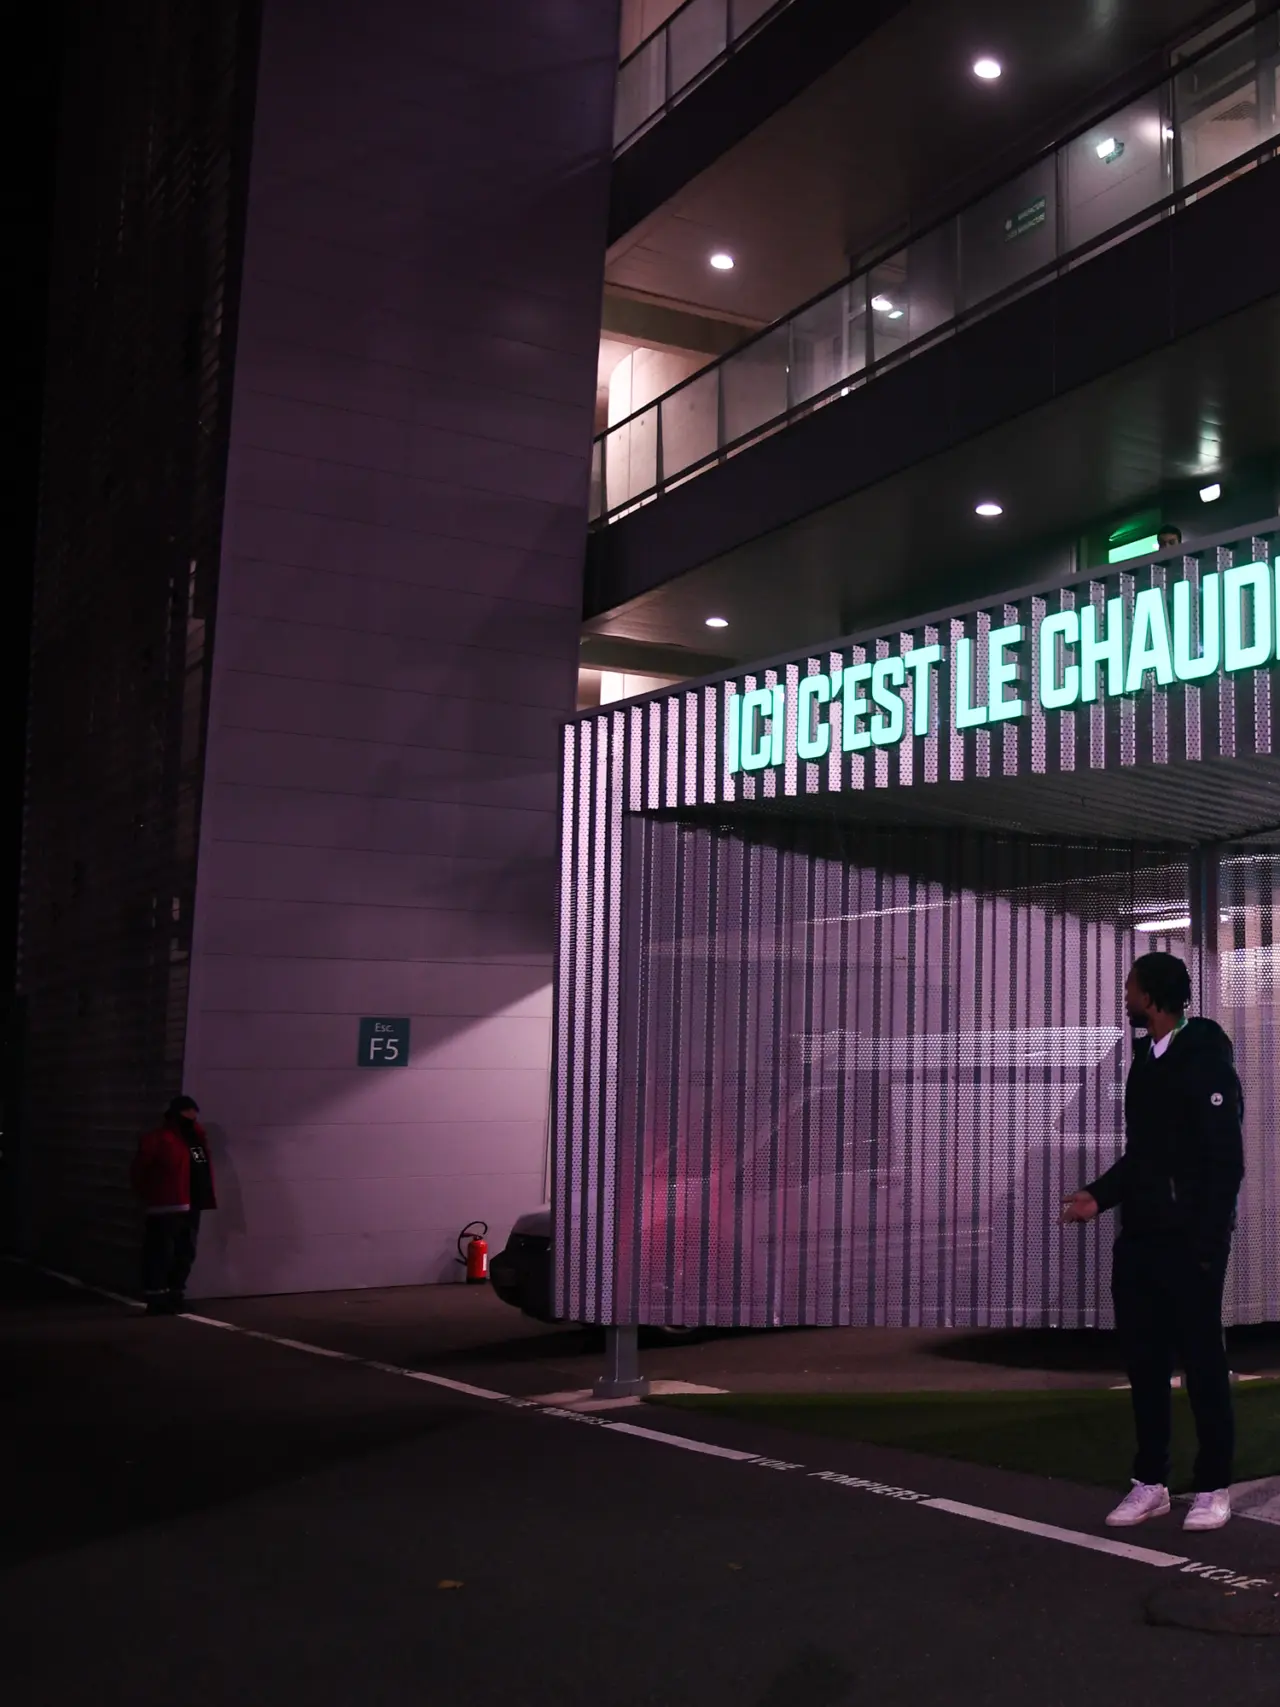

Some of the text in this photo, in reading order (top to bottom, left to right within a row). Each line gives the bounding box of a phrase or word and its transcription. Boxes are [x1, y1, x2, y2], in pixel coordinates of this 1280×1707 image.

[729, 684, 785, 774] ICI
[796, 645, 943, 760] C'EST
[955, 624, 1023, 730] LE
[369, 1037, 400, 1061] F5
[806, 1470, 930, 1501] POMPIERS
[1178, 1561, 1273, 1590] VOIE
